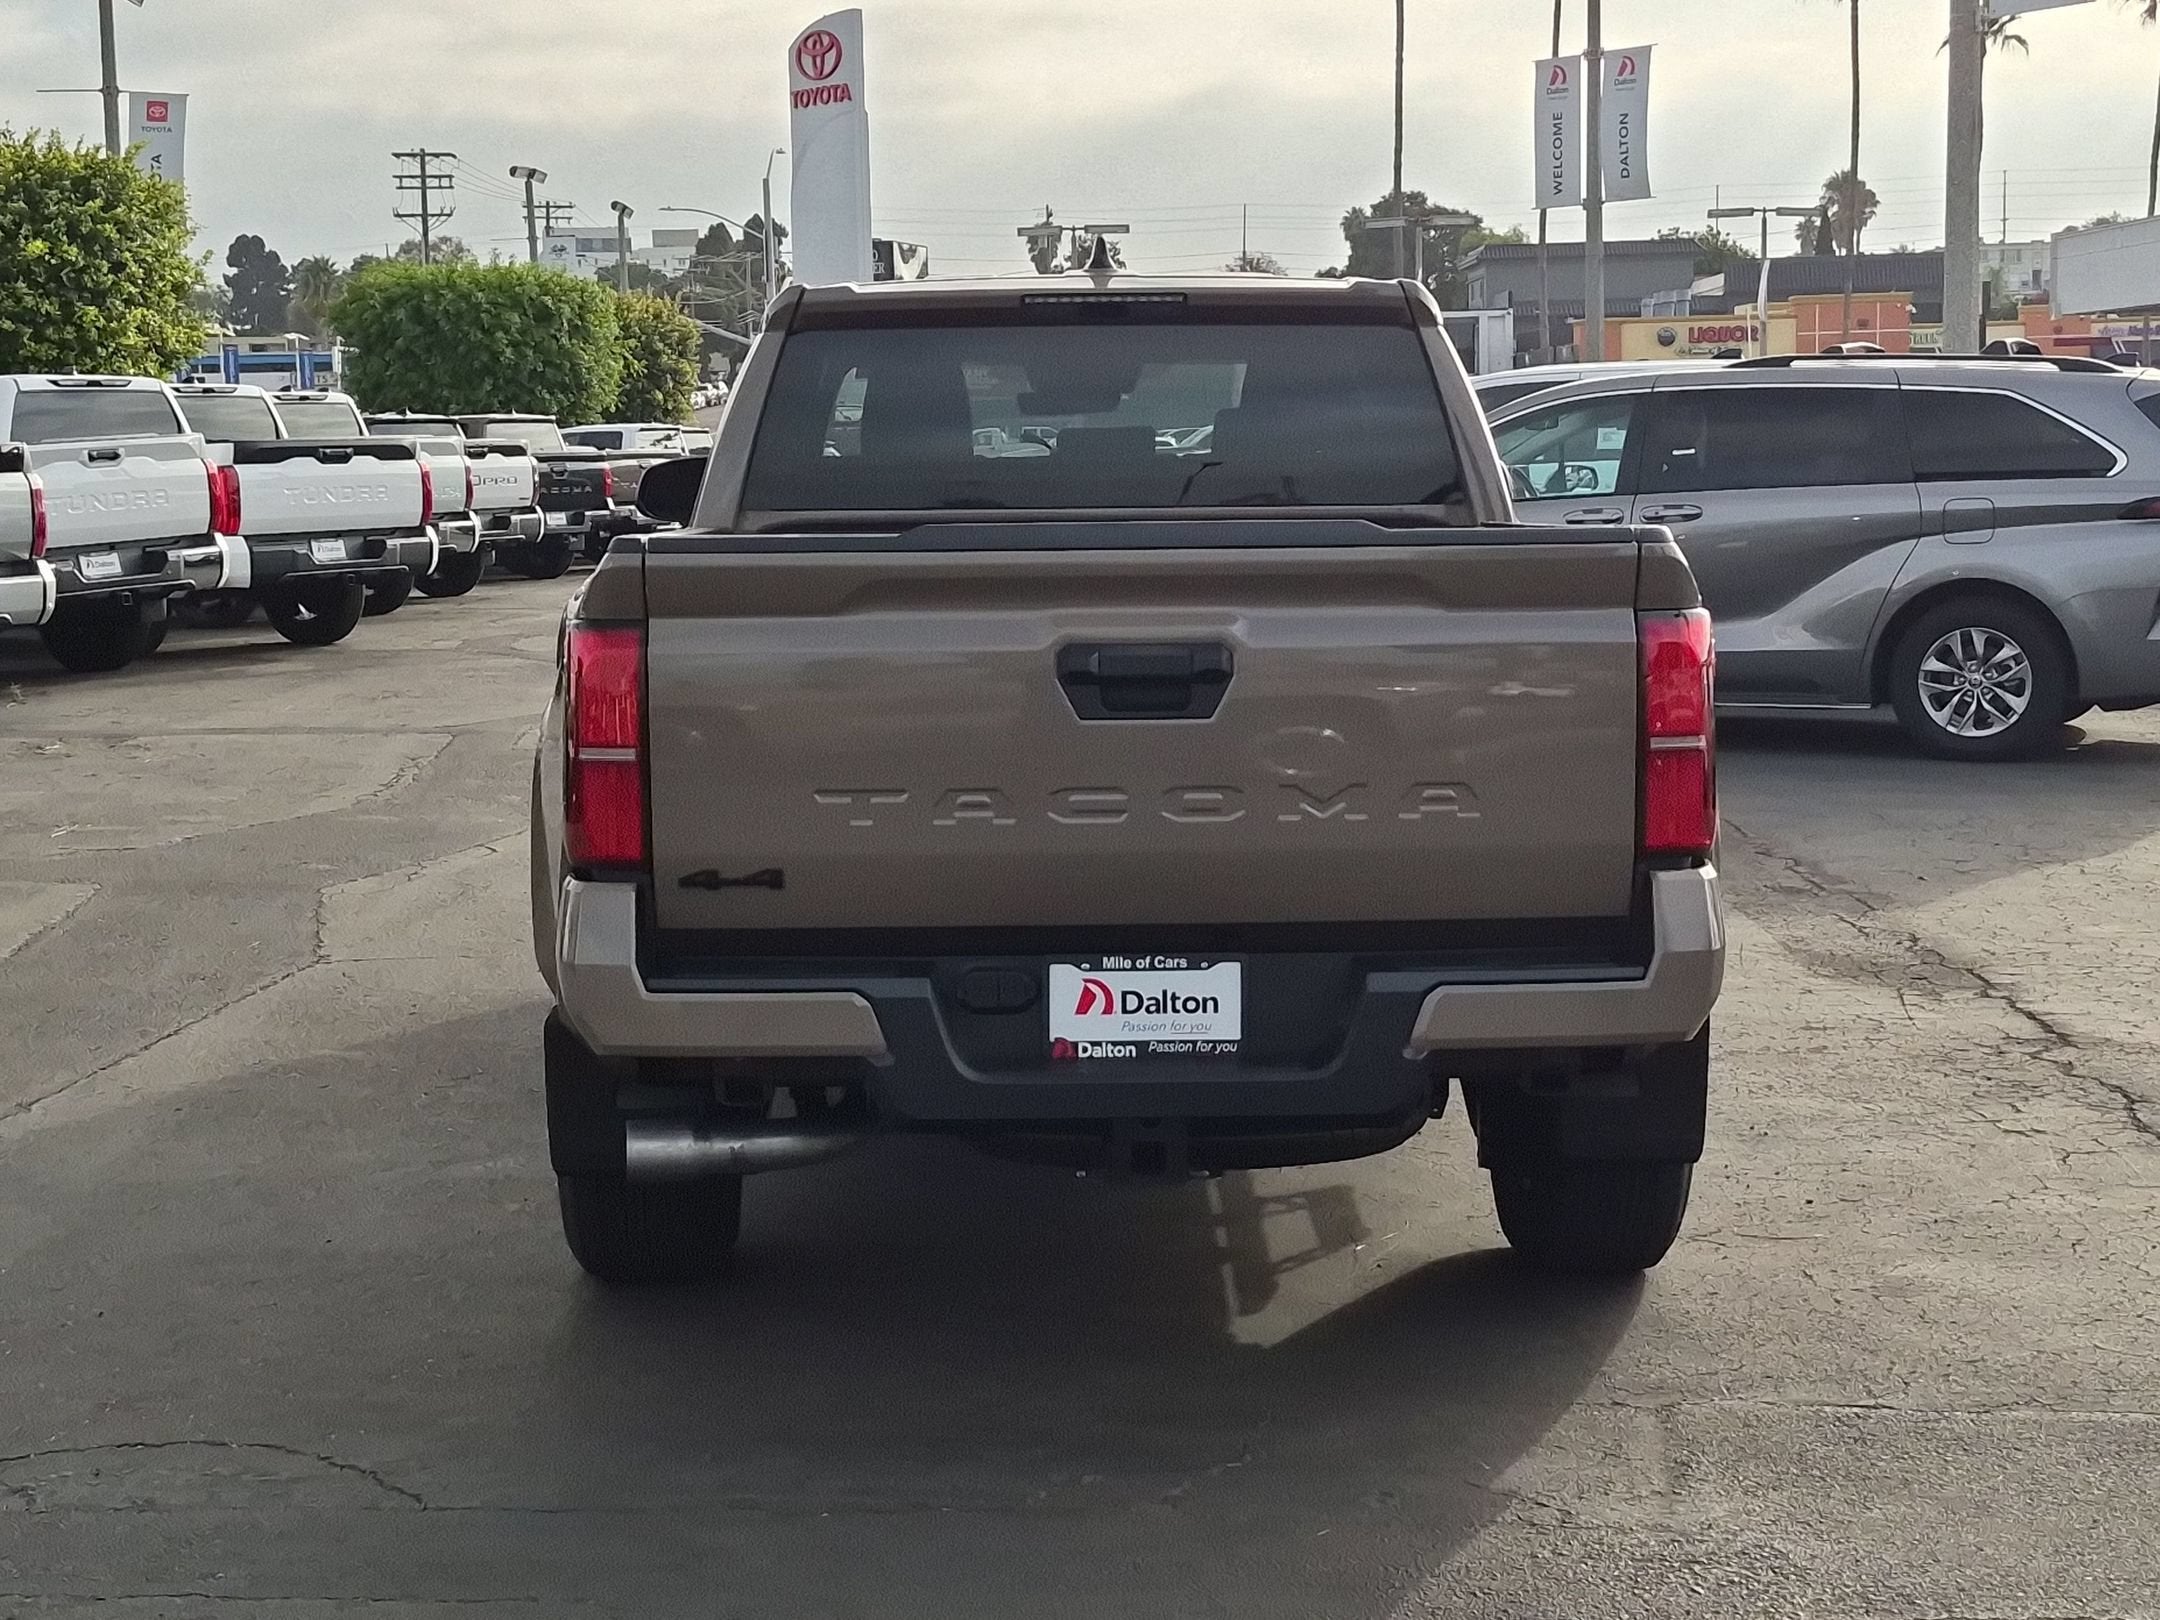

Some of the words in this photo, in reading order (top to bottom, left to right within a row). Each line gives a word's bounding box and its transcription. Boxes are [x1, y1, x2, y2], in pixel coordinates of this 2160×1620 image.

[791, 83, 852, 109] TOYOTA
[1553, 112, 1563, 195] WELCOME
[1619, 113, 1630, 178] DALTON
[1688, 325, 1759, 343] LIQUOR
[46, 489, 169, 515] TUNDRA
[283, 484, 388, 504] TUNDRA
[812, 783, 1482, 826] TACOMA
[1103, 956, 1131, 969] Mile
[1135, 956, 1150, 969] of
[1154, 956, 1188, 969] Cars
[1121, 989, 1219, 1015] Dalton
[1121, 1021, 1166, 1032] Passion
[1170, 1020, 1188, 1032] for
[1190, 1023, 1212, 1034] you
[1078, 1042, 1136, 1058] Dalton
[1149, 1041, 1193, 1053] Passion
[1196, 1041, 1213, 1052] for
[1215, 1043, 1238, 1054] you
